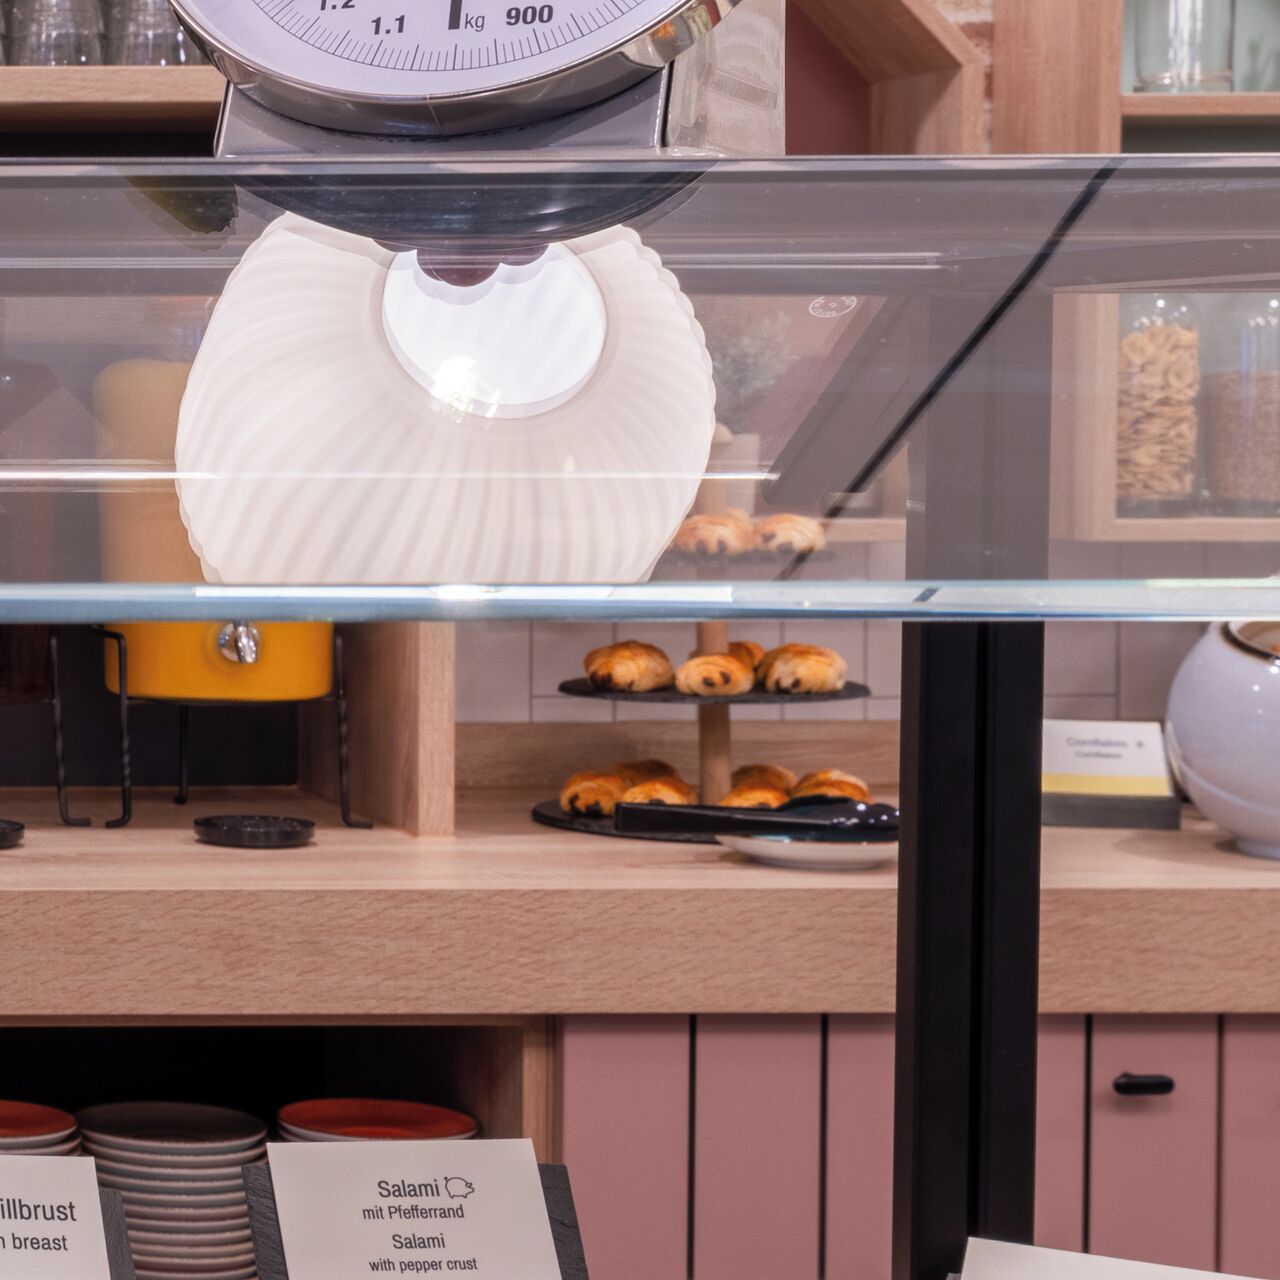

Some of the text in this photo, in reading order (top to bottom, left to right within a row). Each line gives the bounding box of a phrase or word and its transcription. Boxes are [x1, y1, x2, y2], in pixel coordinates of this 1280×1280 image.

[465, 13, 485, 32] kg
[506, 5, 553, 26] 900
[372, 15, 405, 35] 1.1
[378, 1179, 440, 1198] Salami
[362, 1204, 464, 1219] mit Pfefferrand
[12, 1233, 68, 1251] breast
[392, 1233, 445, 1249] Salami
[369, 1258, 478, 1274] with pepper crust
